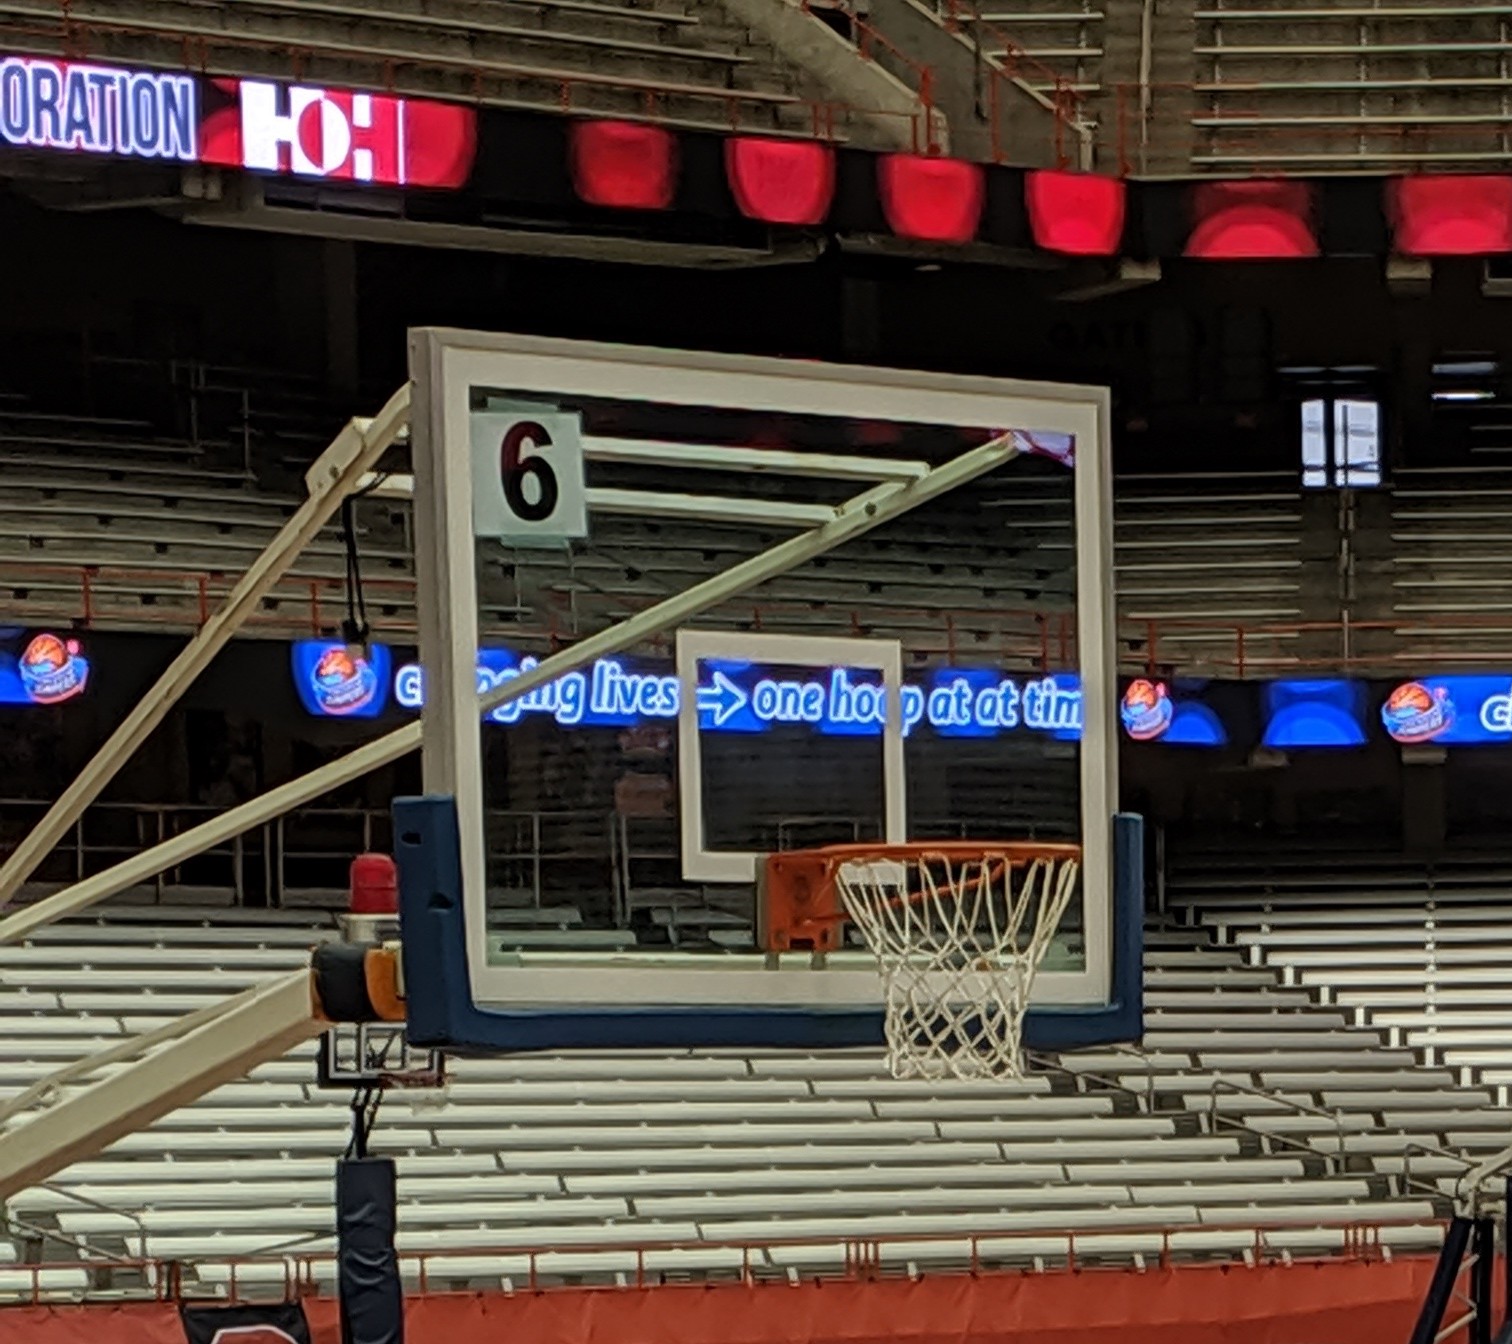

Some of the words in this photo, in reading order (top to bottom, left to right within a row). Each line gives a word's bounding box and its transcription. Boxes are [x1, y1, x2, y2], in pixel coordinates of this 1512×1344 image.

[501, 420, 558, 522] 6
[591, 659, 680, 715] lives
[754, 679, 822, 722] one
[928, 676, 976, 727] at
[976, 678, 1019, 729] at
[1022, 678, 1083, 730] tim
